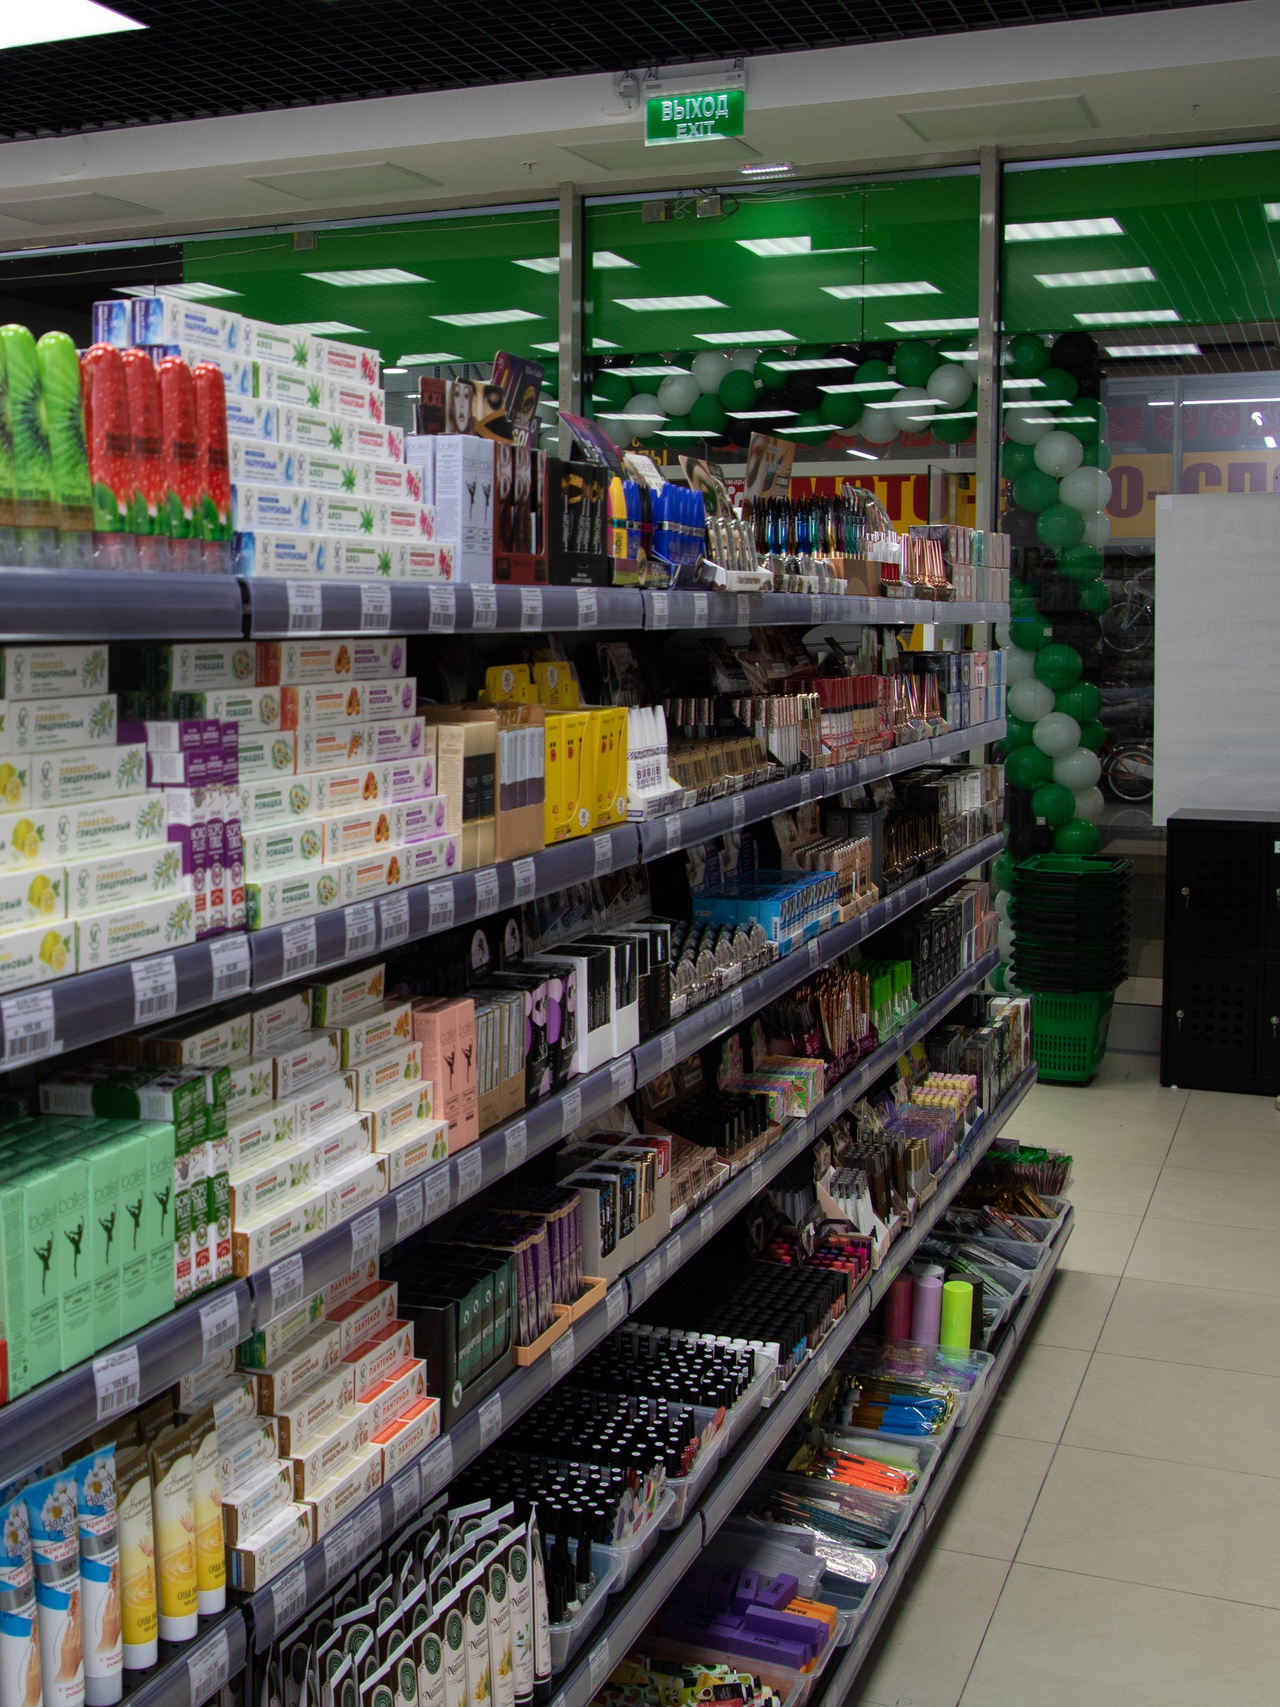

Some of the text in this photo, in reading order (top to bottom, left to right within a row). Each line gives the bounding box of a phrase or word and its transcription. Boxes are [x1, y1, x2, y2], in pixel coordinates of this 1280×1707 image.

[661, 94, 729, 121] ВЫХОД
[676, 120, 715, 138] EXIT
[330, 1271, 360, 1294] ПАНТЕНОЛ
[369, 1350, 397, 1375] ПАНТЕНОЛ
[382, 1389, 409, 1415] ПАНТЕНОЛ
[398, 1430, 424, 1455] ПАНТЕНОЛ
